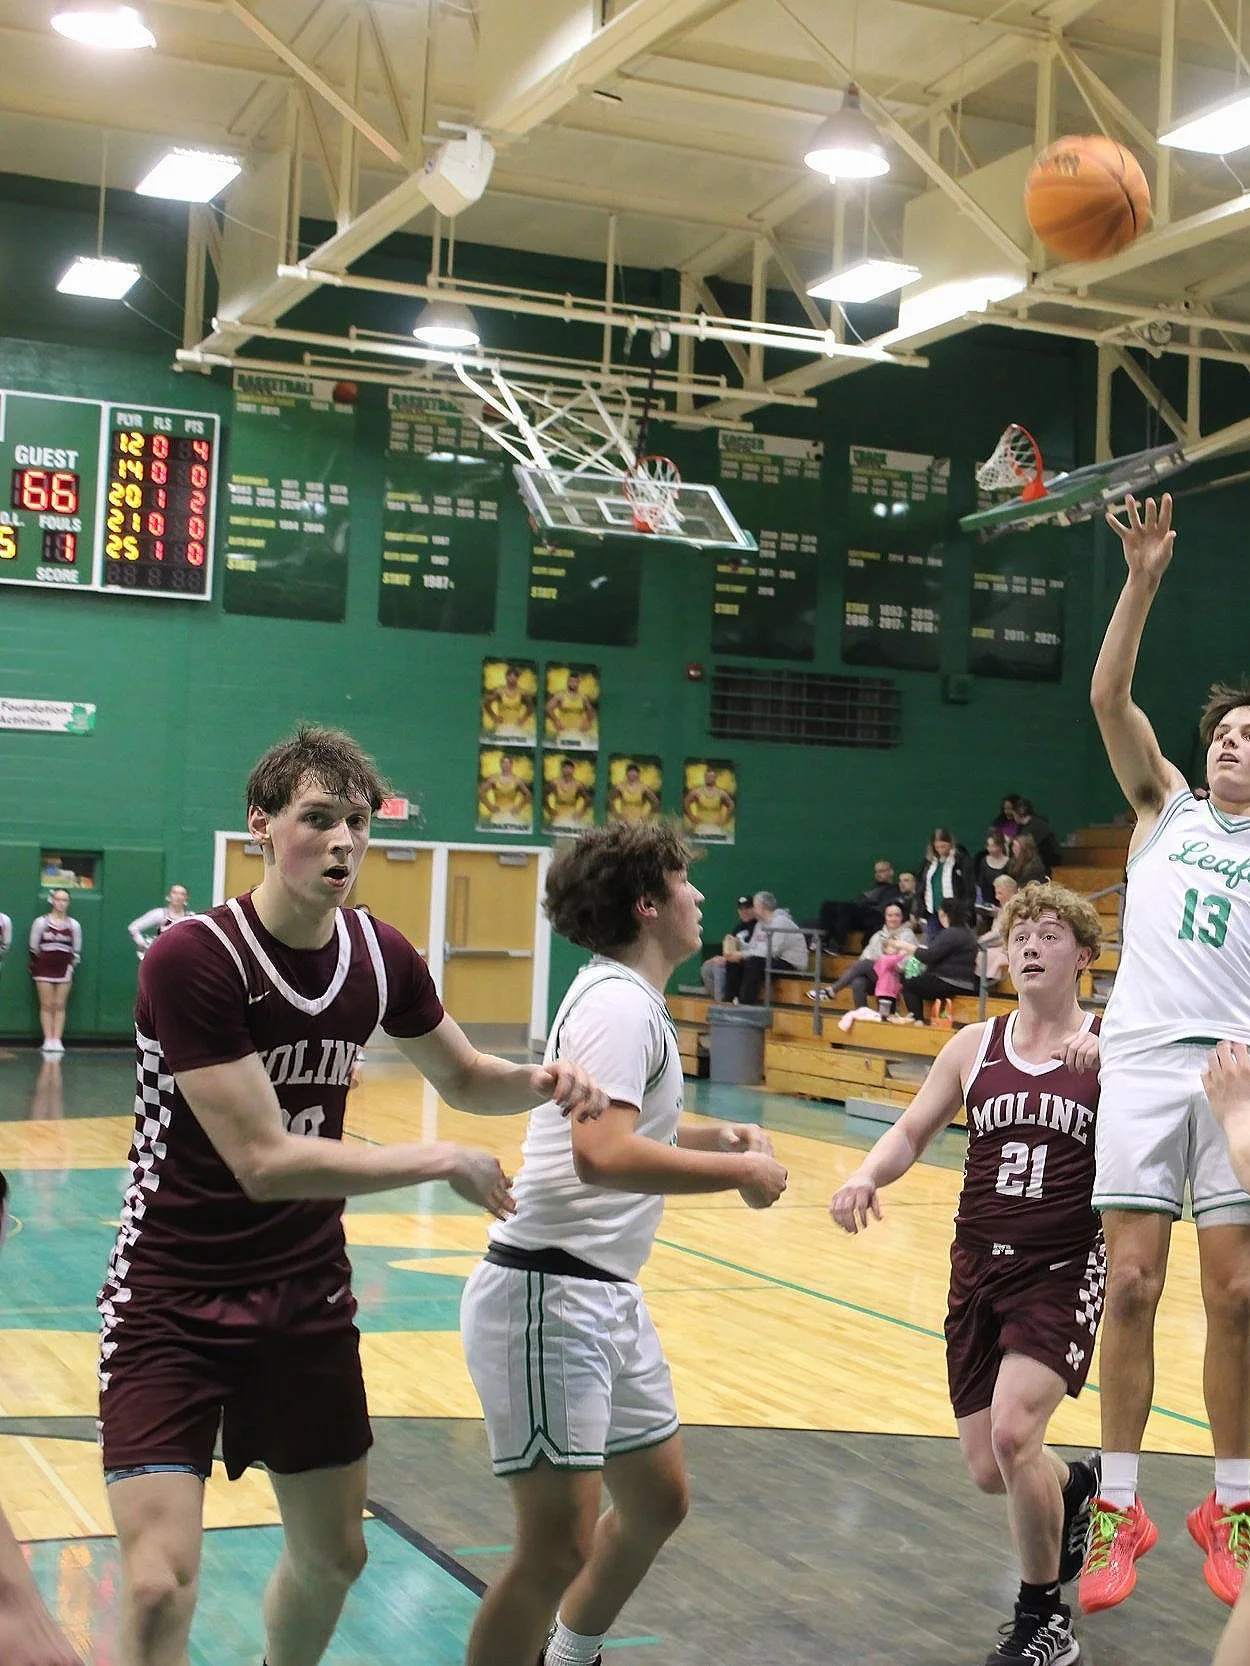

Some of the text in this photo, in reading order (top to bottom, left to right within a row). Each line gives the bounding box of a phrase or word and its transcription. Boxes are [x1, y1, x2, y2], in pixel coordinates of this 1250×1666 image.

[153, 416, 172, 431] FLS
[184, 419, 205, 434] PTS
[15, 444, 79, 469] GUEST
[119, 432, 209, 461] 12 0 4
[118, 459, 208, 489] 14 0 0
[23, 470, 77, 513] 66
[108, 482, 143, 508] 20
[157, 488, 167, 509] 1
[189, 490, 207, 515] 2
[39, 515, 81, 532] FOULS
[106, 508, 141, 533] 21
[148, 511, 165, 537] 0
[188, 516, 206, 541] 0
[65, 533, 75, 562] 1
[105, 534, 140, 561] 25
[155, 540, 164, 561] 1
[187, 541, 205, 567] 0
[36, 566, 79, 583] SCORE
[1178, 888, 1231, 948] 13
[259, 1040, 363, 1086] OLIN
[972, 1092, 1095, 1145] MOLINE
[995, 1141, 1048, 1199] 21
